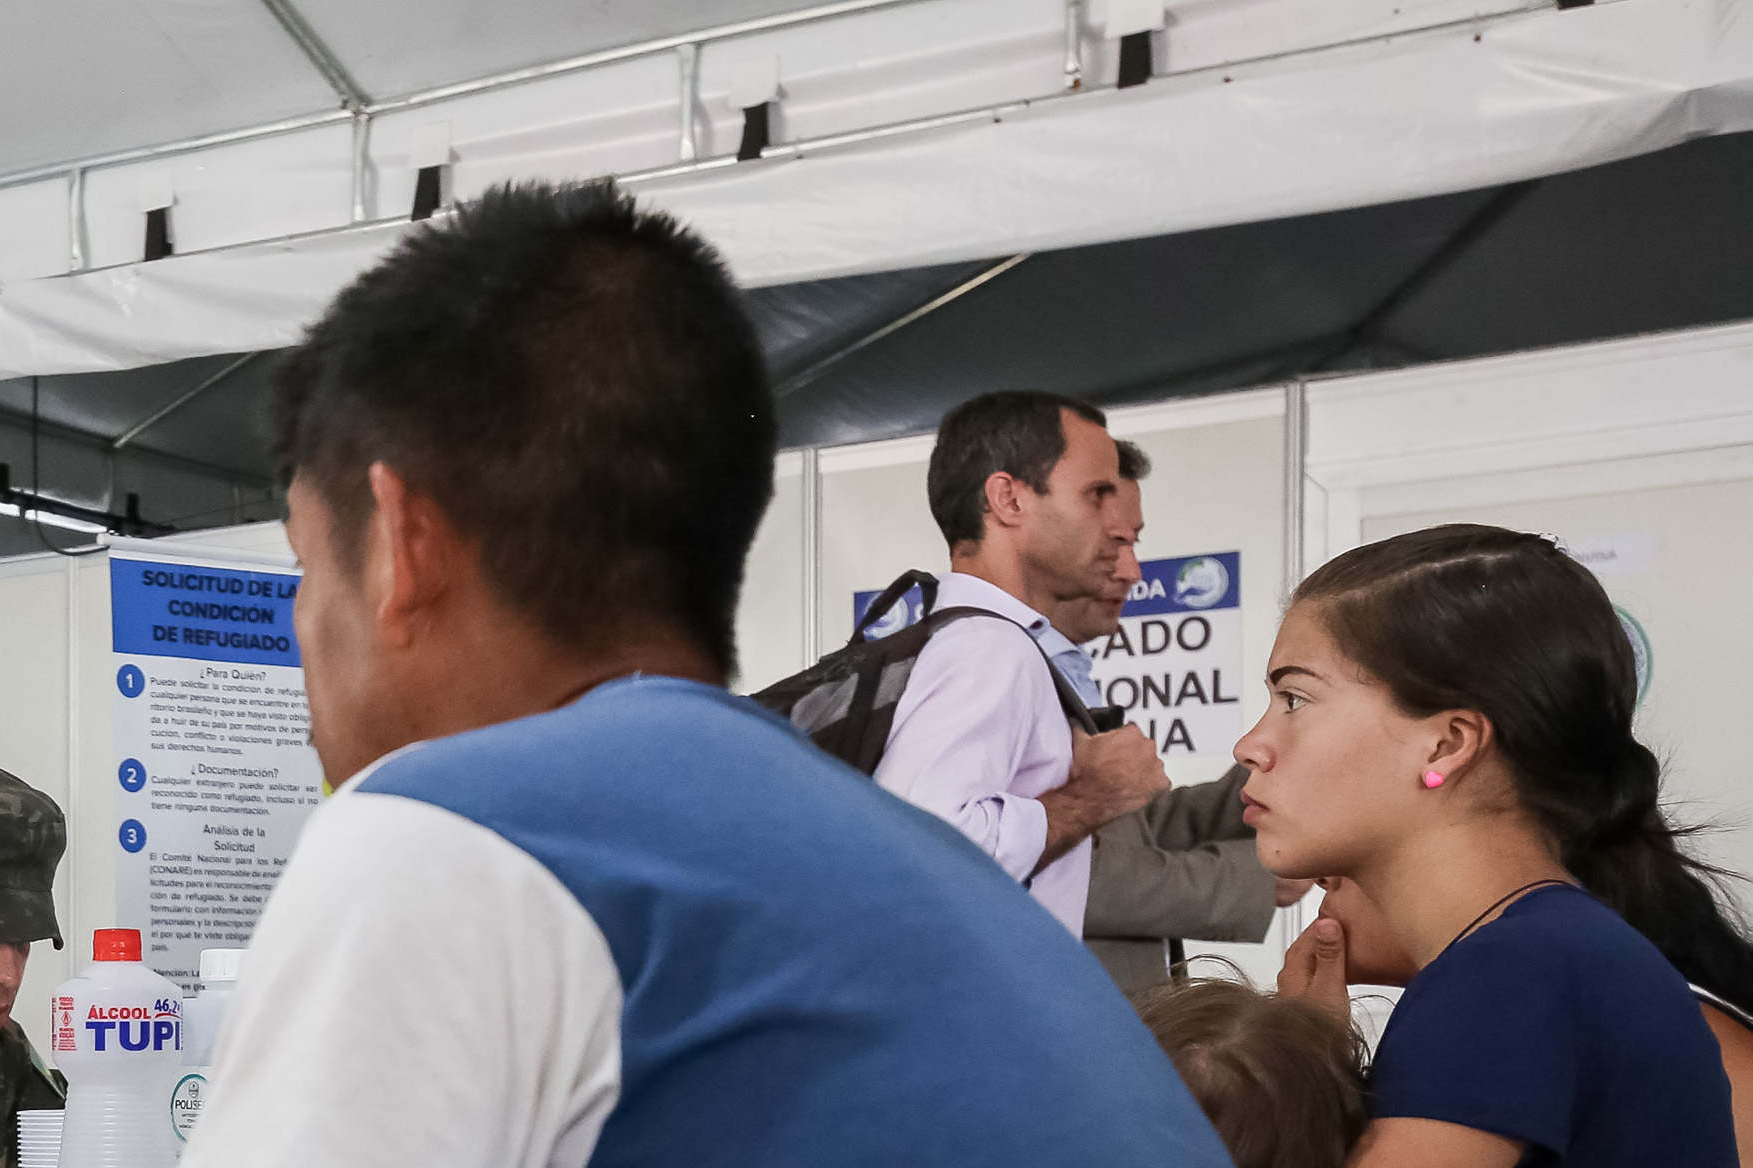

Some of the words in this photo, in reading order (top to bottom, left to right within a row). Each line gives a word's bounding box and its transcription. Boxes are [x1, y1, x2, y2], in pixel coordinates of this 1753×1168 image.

[142, 570, 244, 594] SOLICITUD
[248, 580, 273, 598] DE
[168, 600, 275, 624] CONDICIÓN
[152, 624, 178, 642] DE
[182, 627, 290, 652] REFUGIADO
[1091, 615, 1212, 660] ADO
[125, 673, 134, 688] 1
[1126, 718, 1196, 754] IA
[126, 769, 137, 783] 2
[127, 828, 137, 843] 3
[203, 823, 240, 836] Análisis
[242, 826, 254, 837] de
[257, 827, 266, 838] la
[214, 840, 256, 853] Solicitud
[87, 1004, 152, 1020] ÁLCOOL
[85, 1021, 181, 1052] TUPI
